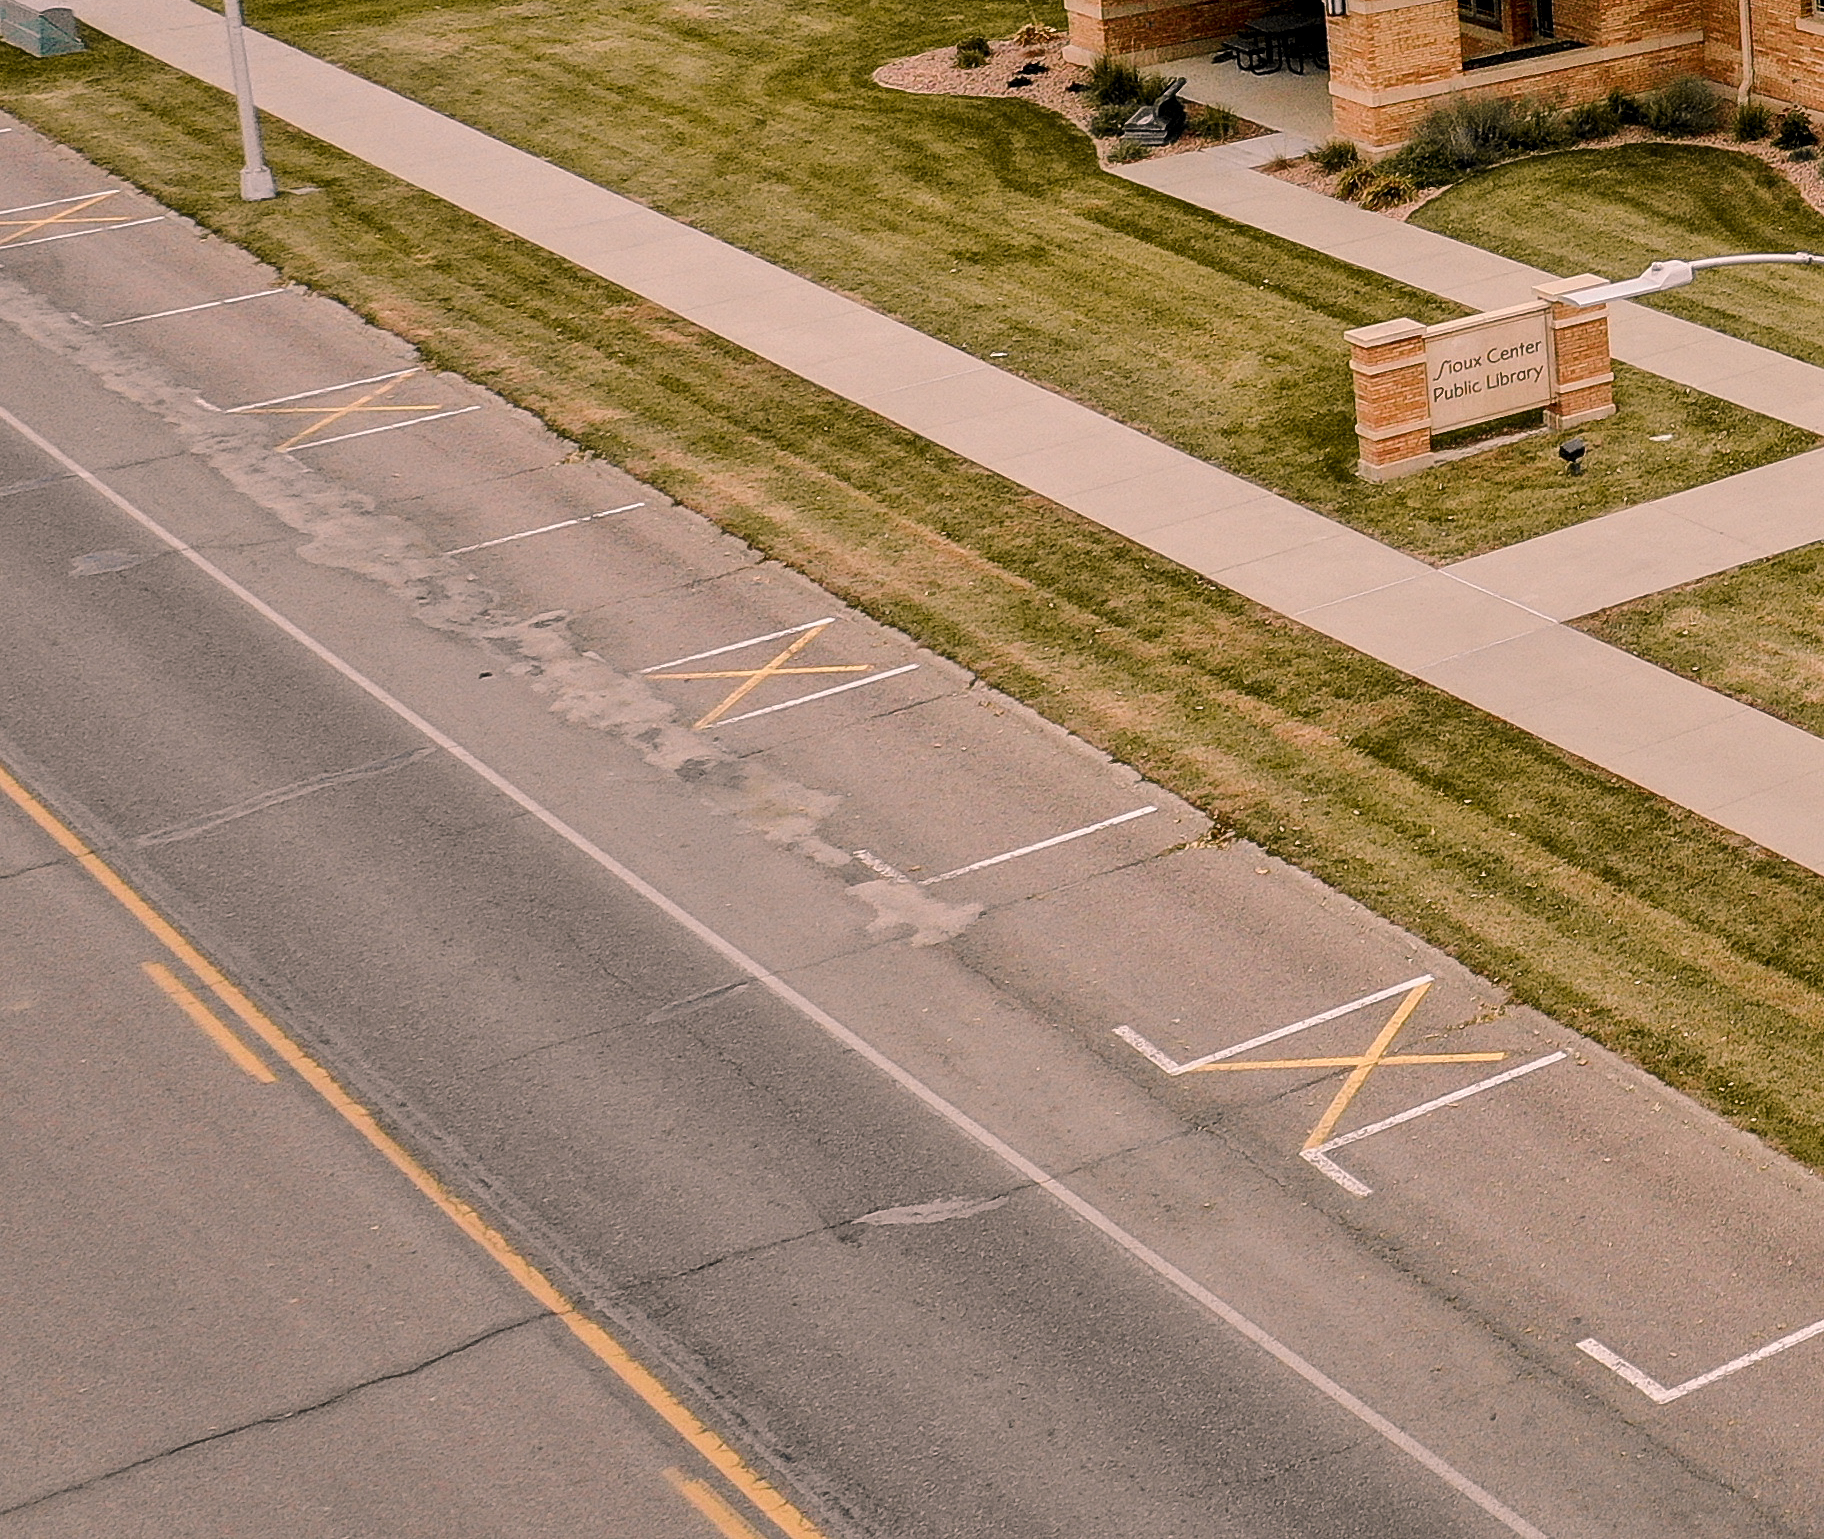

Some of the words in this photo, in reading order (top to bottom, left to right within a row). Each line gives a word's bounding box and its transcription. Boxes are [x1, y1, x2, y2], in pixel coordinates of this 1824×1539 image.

[1432, 355, 1483, 382] Sioux
[1486, 340, 1542, 364] Center
[1433, 380, 1483, 403] Public
[1486, 365, 1544, 390] Library
